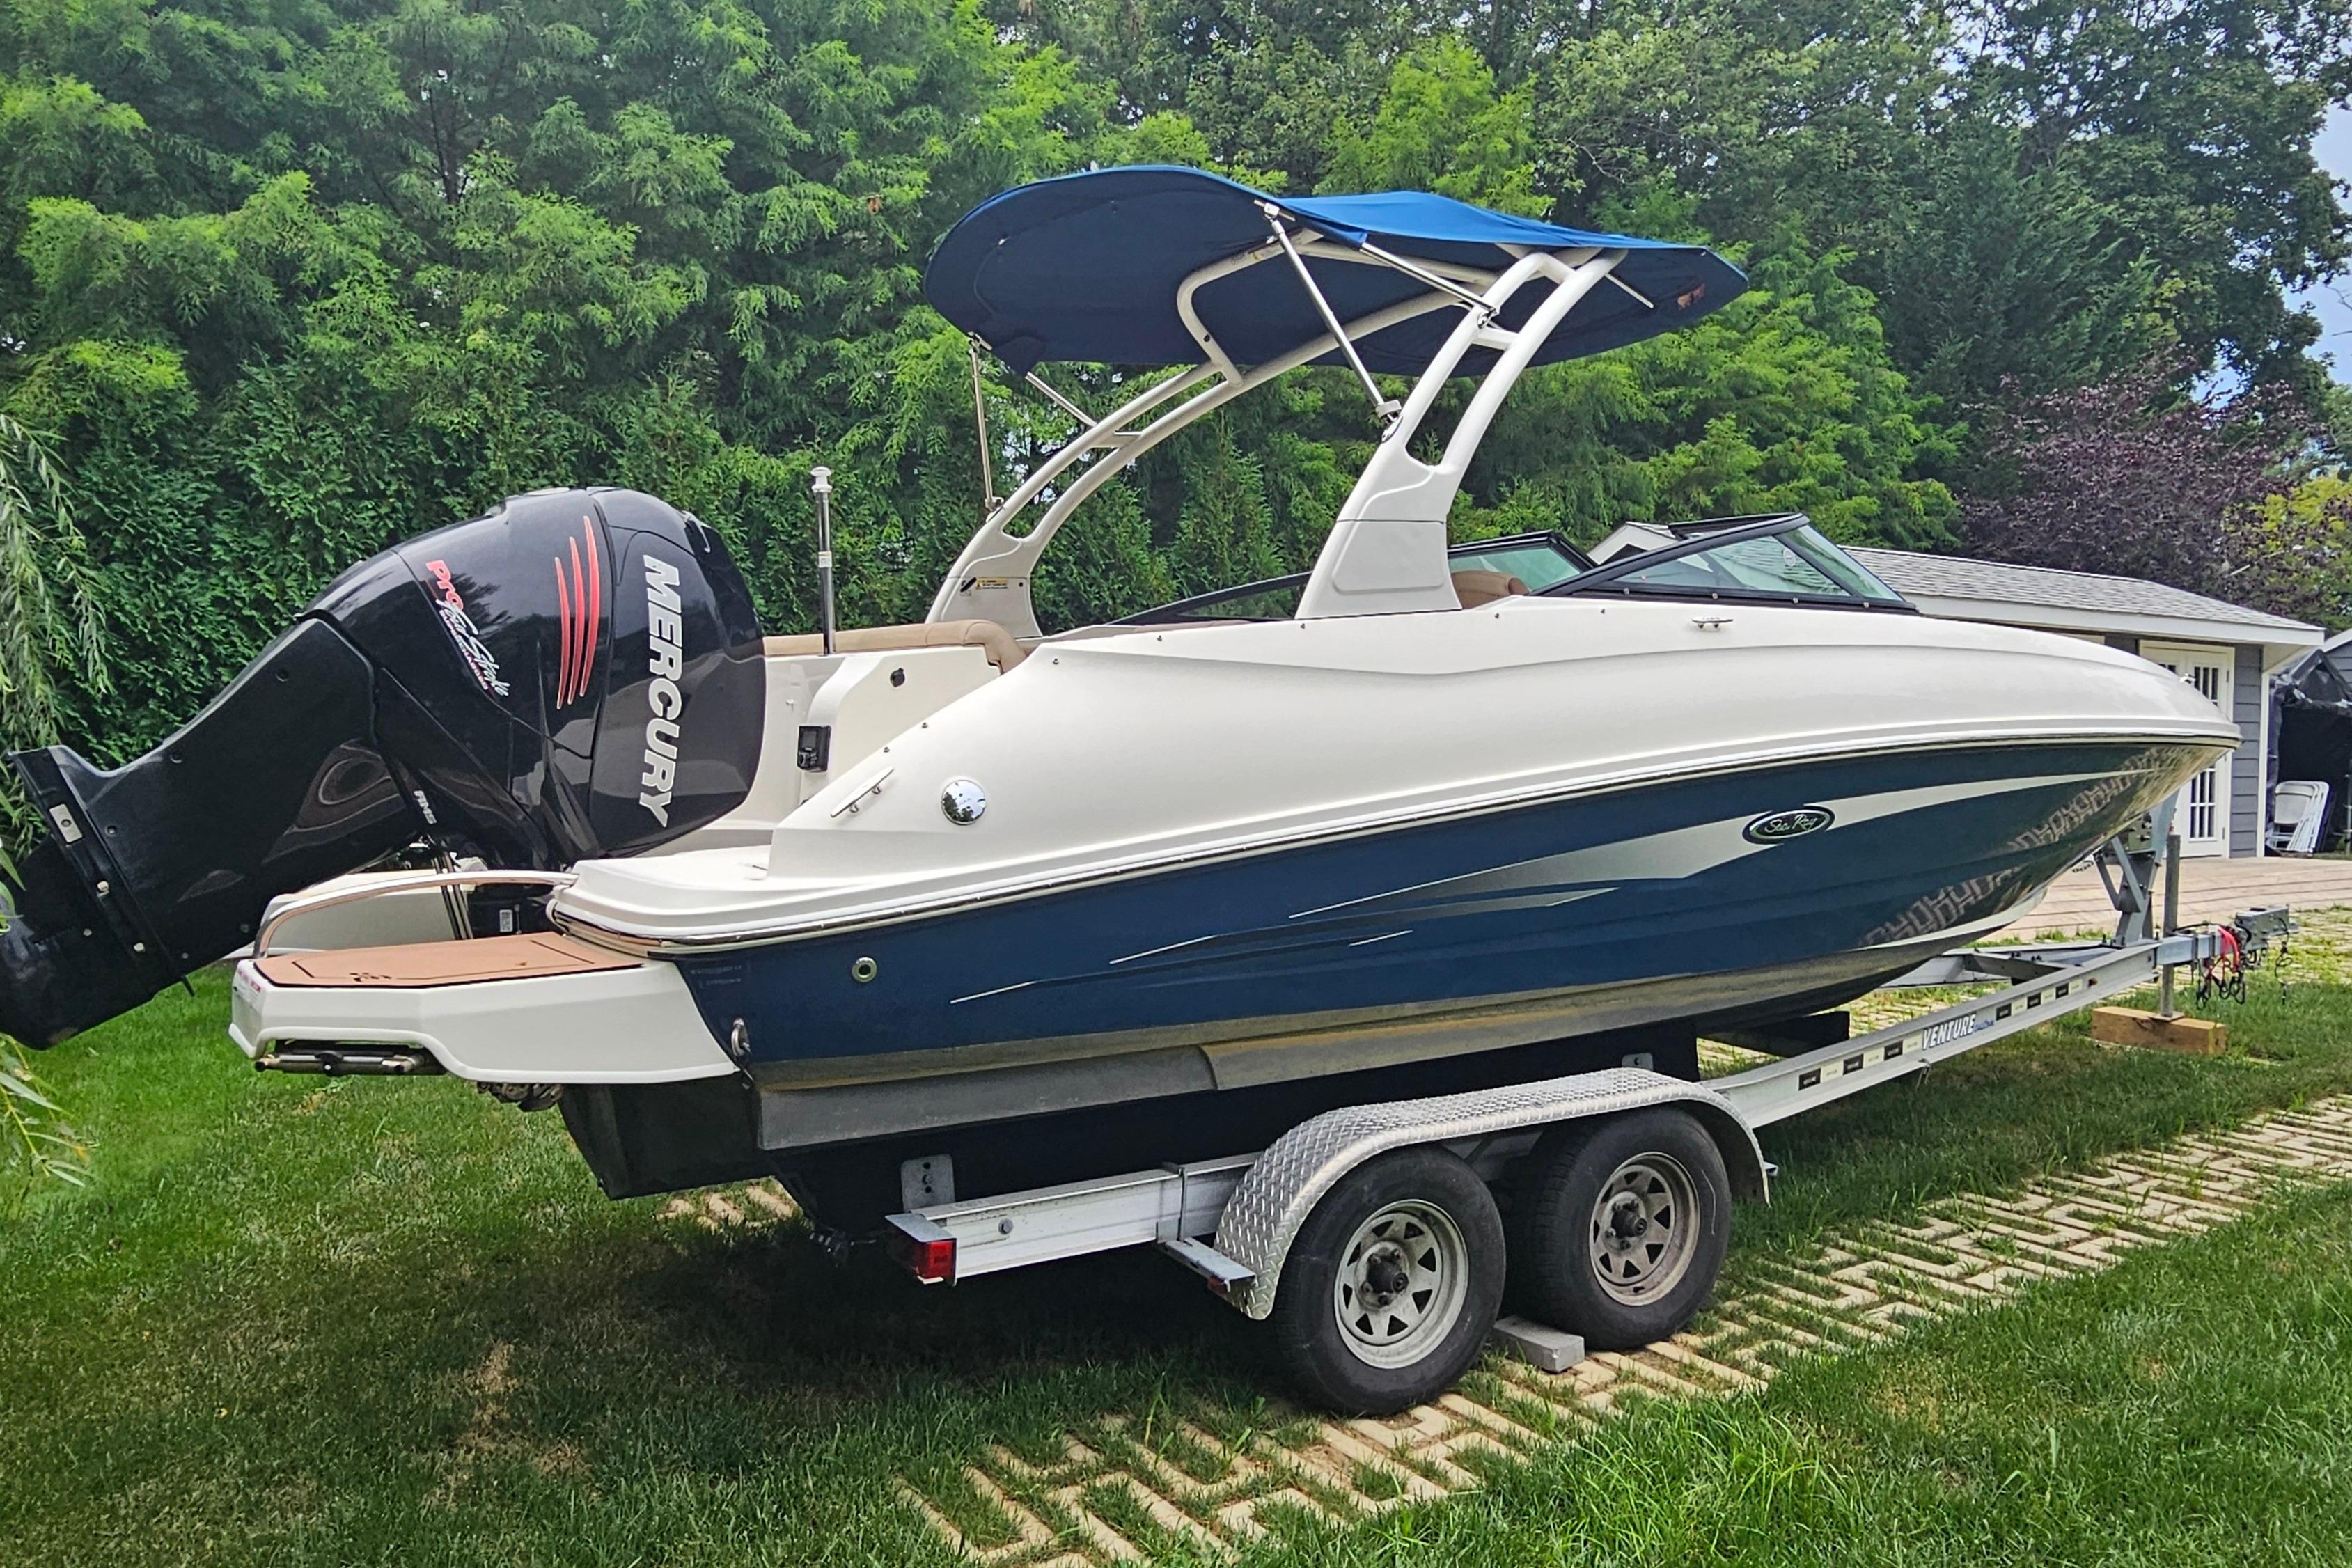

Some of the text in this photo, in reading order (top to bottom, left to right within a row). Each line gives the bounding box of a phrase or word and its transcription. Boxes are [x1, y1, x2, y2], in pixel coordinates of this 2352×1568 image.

[425, 559, 464, 611] Pro
[639, 554, 682, 828] MERCURY
[413, 790, 437, 825] AMS
[1764, 813, 1819, 833] Sea Ray
[1922, 1013, 1976, 1051] VENTURE
